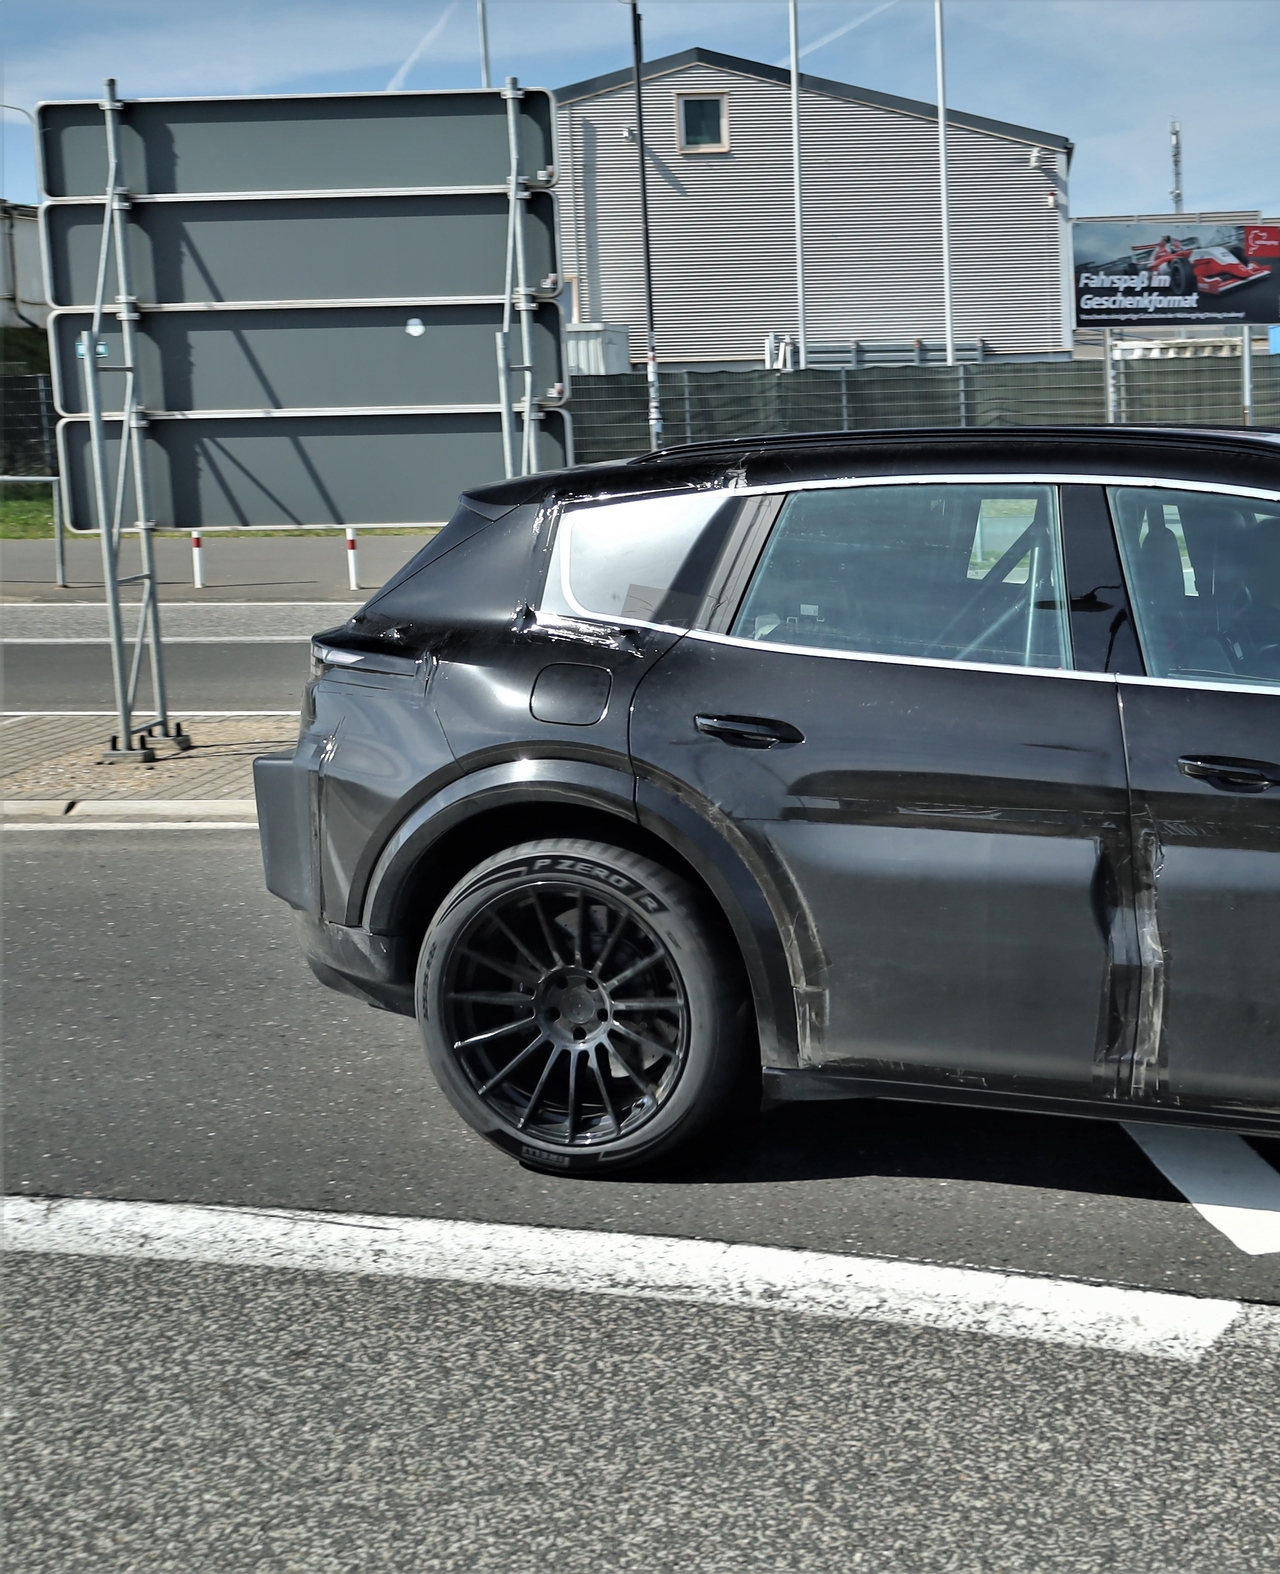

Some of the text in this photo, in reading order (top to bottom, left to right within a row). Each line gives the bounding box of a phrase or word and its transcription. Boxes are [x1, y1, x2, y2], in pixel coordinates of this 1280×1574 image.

[1078, 271, 1171, 292] Fahrspaß im
[1079, 291, 1199, 312] Geschenkformat
[533, 858, 552, 871] P
[554, 859, 632, 889] ZERO
